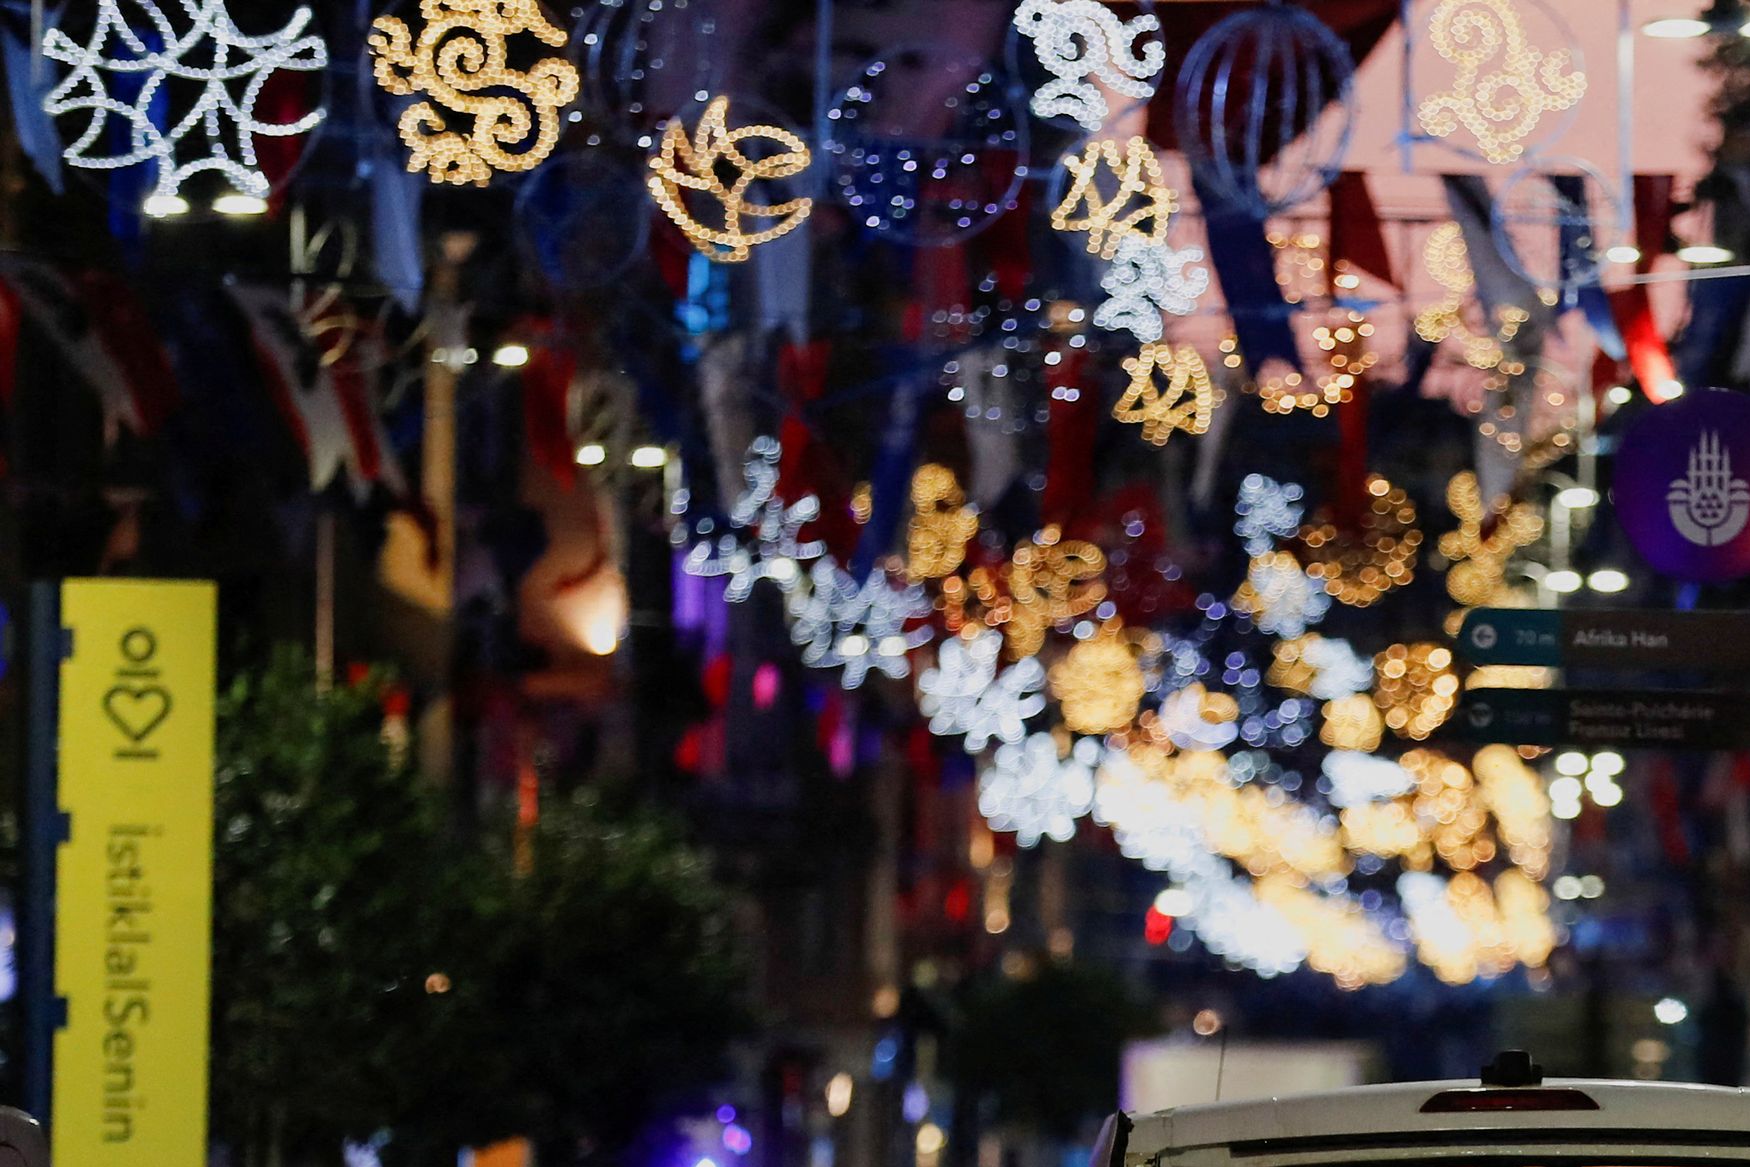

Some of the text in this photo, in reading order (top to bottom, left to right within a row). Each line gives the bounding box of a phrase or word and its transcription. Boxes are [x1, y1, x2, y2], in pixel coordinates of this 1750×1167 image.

[1538, 633, 1556, 646] m
[1572, 628, 1628, 647] Afrika
[1631, 630, 1669, 648] Han
